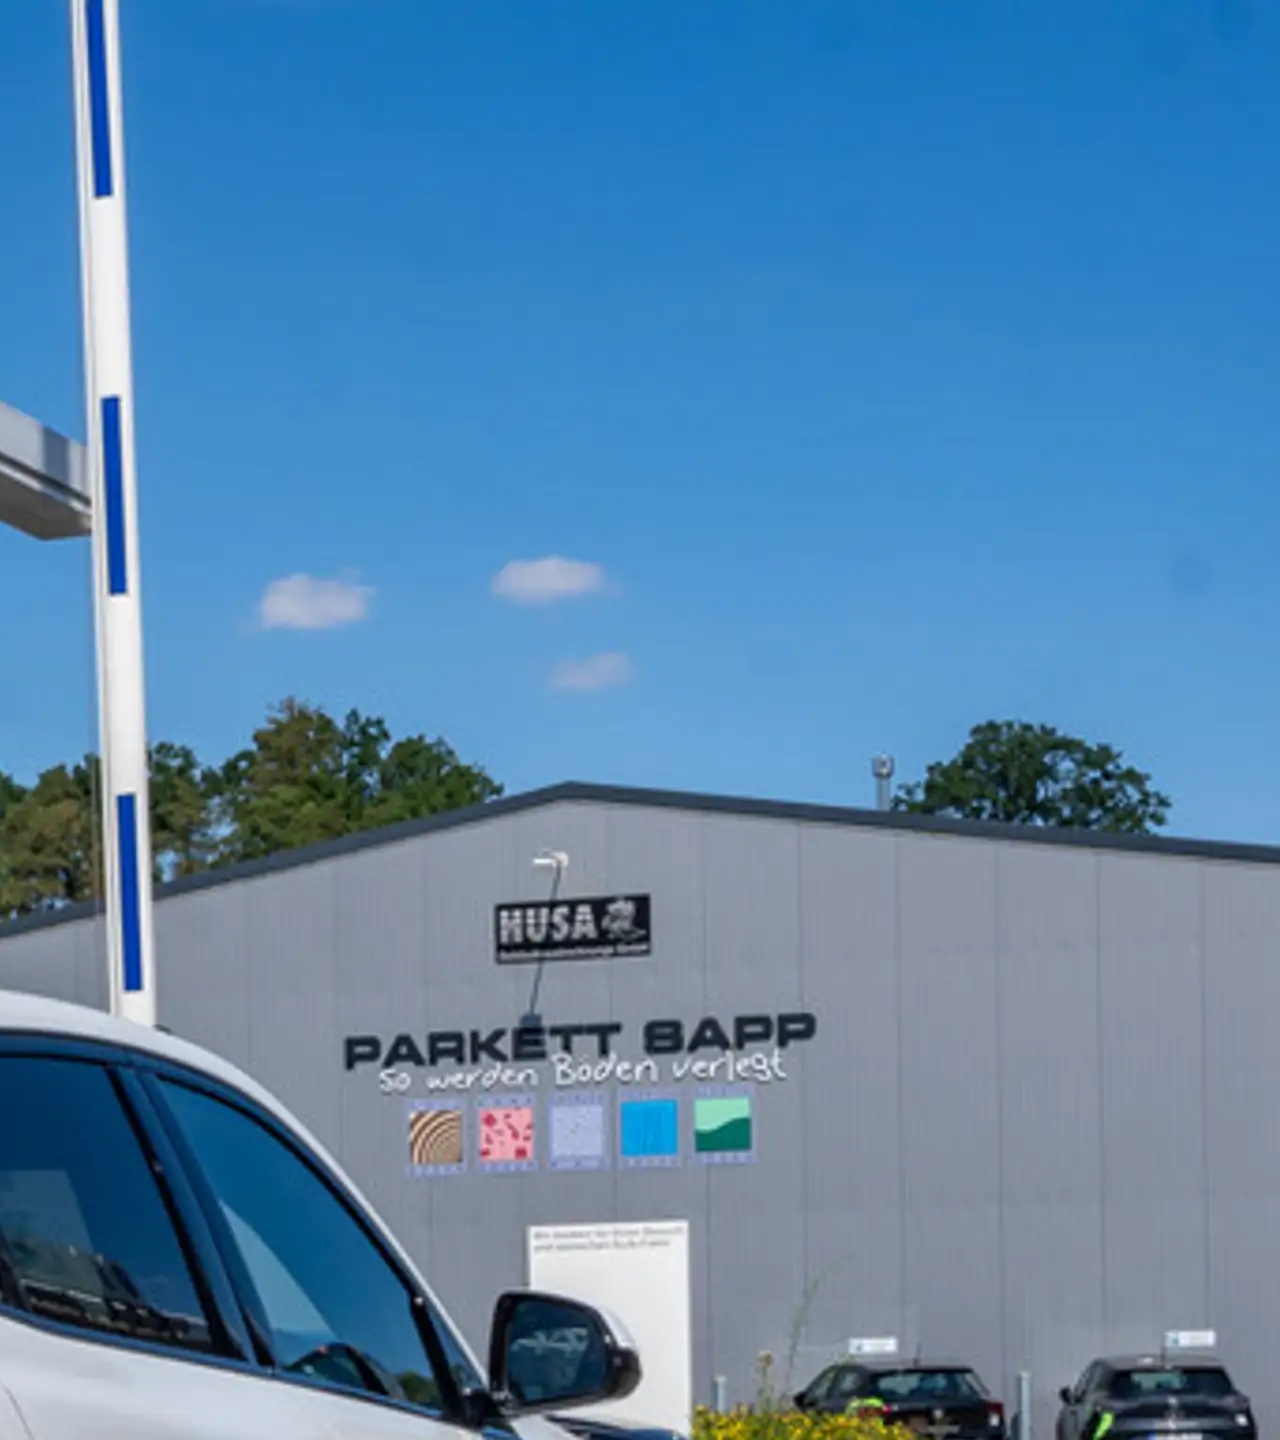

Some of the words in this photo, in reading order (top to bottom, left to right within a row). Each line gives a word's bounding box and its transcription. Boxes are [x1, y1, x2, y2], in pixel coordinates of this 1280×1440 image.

[499, 904, 598, 943] HUSA
[344, 1023, 623, 1070] PARKETT
[425, 1061, 539, 1089] werden
[672, 1048, 787, 1082] verlegt
